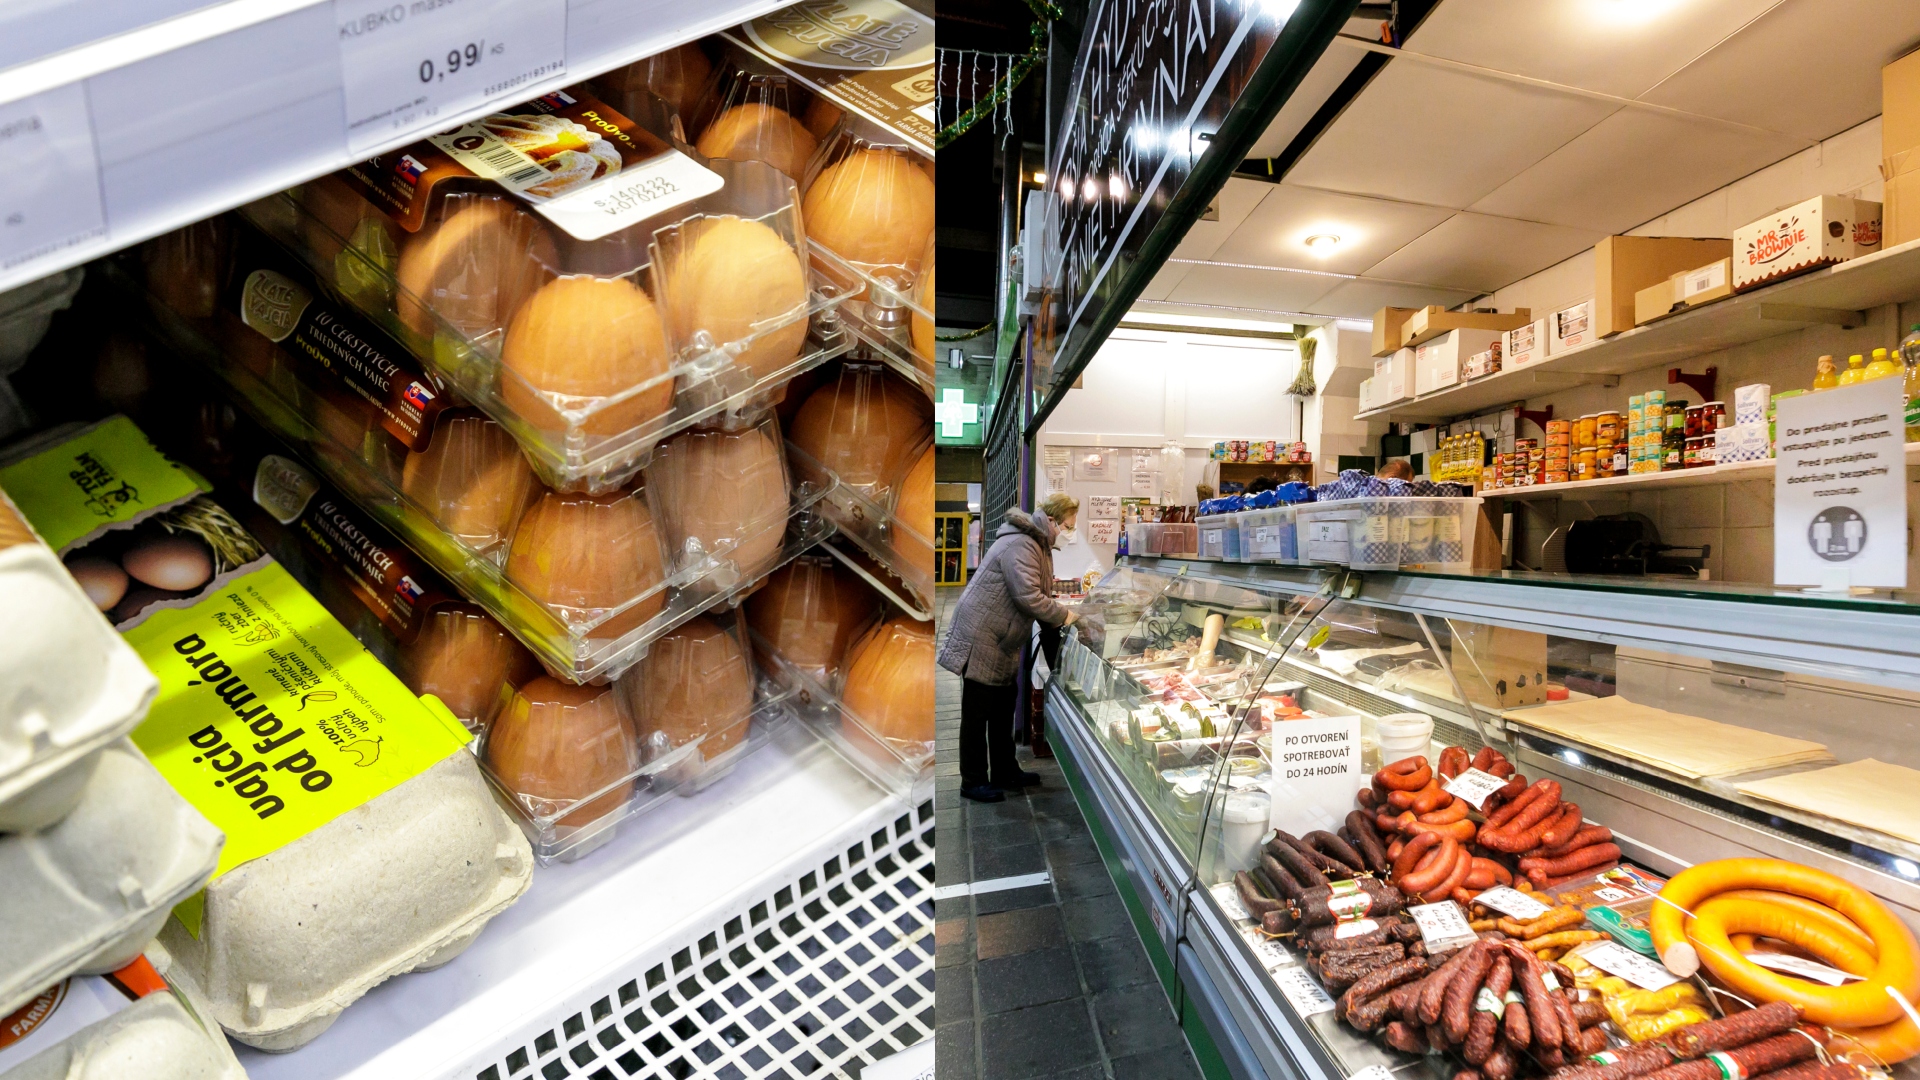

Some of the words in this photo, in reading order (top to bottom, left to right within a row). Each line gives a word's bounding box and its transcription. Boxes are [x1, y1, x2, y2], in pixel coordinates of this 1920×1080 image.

[339, 4, 405, 40] KUBKO
[581, 110, 631, 142] ProOvo
[1750, 229, 1806, 266] BROWNIE
[1757, 230, 1779, 250] MR.
[254, 273, 298, 300] ZLATÉ
[249, 298, 293, 329] VAJCIA
[295, 333, 332, 369] ProOvo
[309, 324, 363, 372] TRIEDENÝCH
[364, 365, 390, 393] VAJEC
[331, 322, 400, 377] ČERSTVÝCH
[383, 407, 418, 438] www.proovo.sk
[1786, 428, 1800, 437] Do
[1803, 421, 1849, 436] predajne
[1782, 440, 1829, 452] vstupujte
[1833, 437, 1846, 447] po
[74, 452, 115, 488] FARM
[1797, 458, 1821, 468] Pred
[69, 470, 100, 495] TOP
[1786, 472, 1836, 484] dodržujte
[333, 513, 394, 571] ČERSTVÝCH
[361, 557, 385, 585] VAJEC
[226, 592, 252, 613] hniezd
[255, 592, 276, 614] úrovni
[210, 611, 239, 636] ručný
[230, 612, 251, 629] zber
[251, 614, 259, 623] z
[273, 611, 283, 621] na
[280, 617, 289, 628] je
[286, 623, 311, 649] hormón
[267, 648, 315, 692] pšeničnými
[289, 651, 323, 685] klíčkami
[307, 643, 334, 673] stresový
[172, 632, 306, 755] farmára
[330, 714, 357, 740] voľný
[342, 707, 370, 733] výbeh
[368, 706, 385, 725] Som
[315, 719, 346, 747] 100%
[1285, 736, 1299, 746] PO
[1301, 730, 1349, 745] OTVORENÍ
[1283, 746, 1351, 763] SPOTREBOVAŤ
[188, 724, 285, 820] vajcia
[272, 748, 334, 793] od
[1286, 769, 1301, 779] DO
[1302, 768, 1315, 777] 24
[1316, 764, 1348, 776] HODÍN
